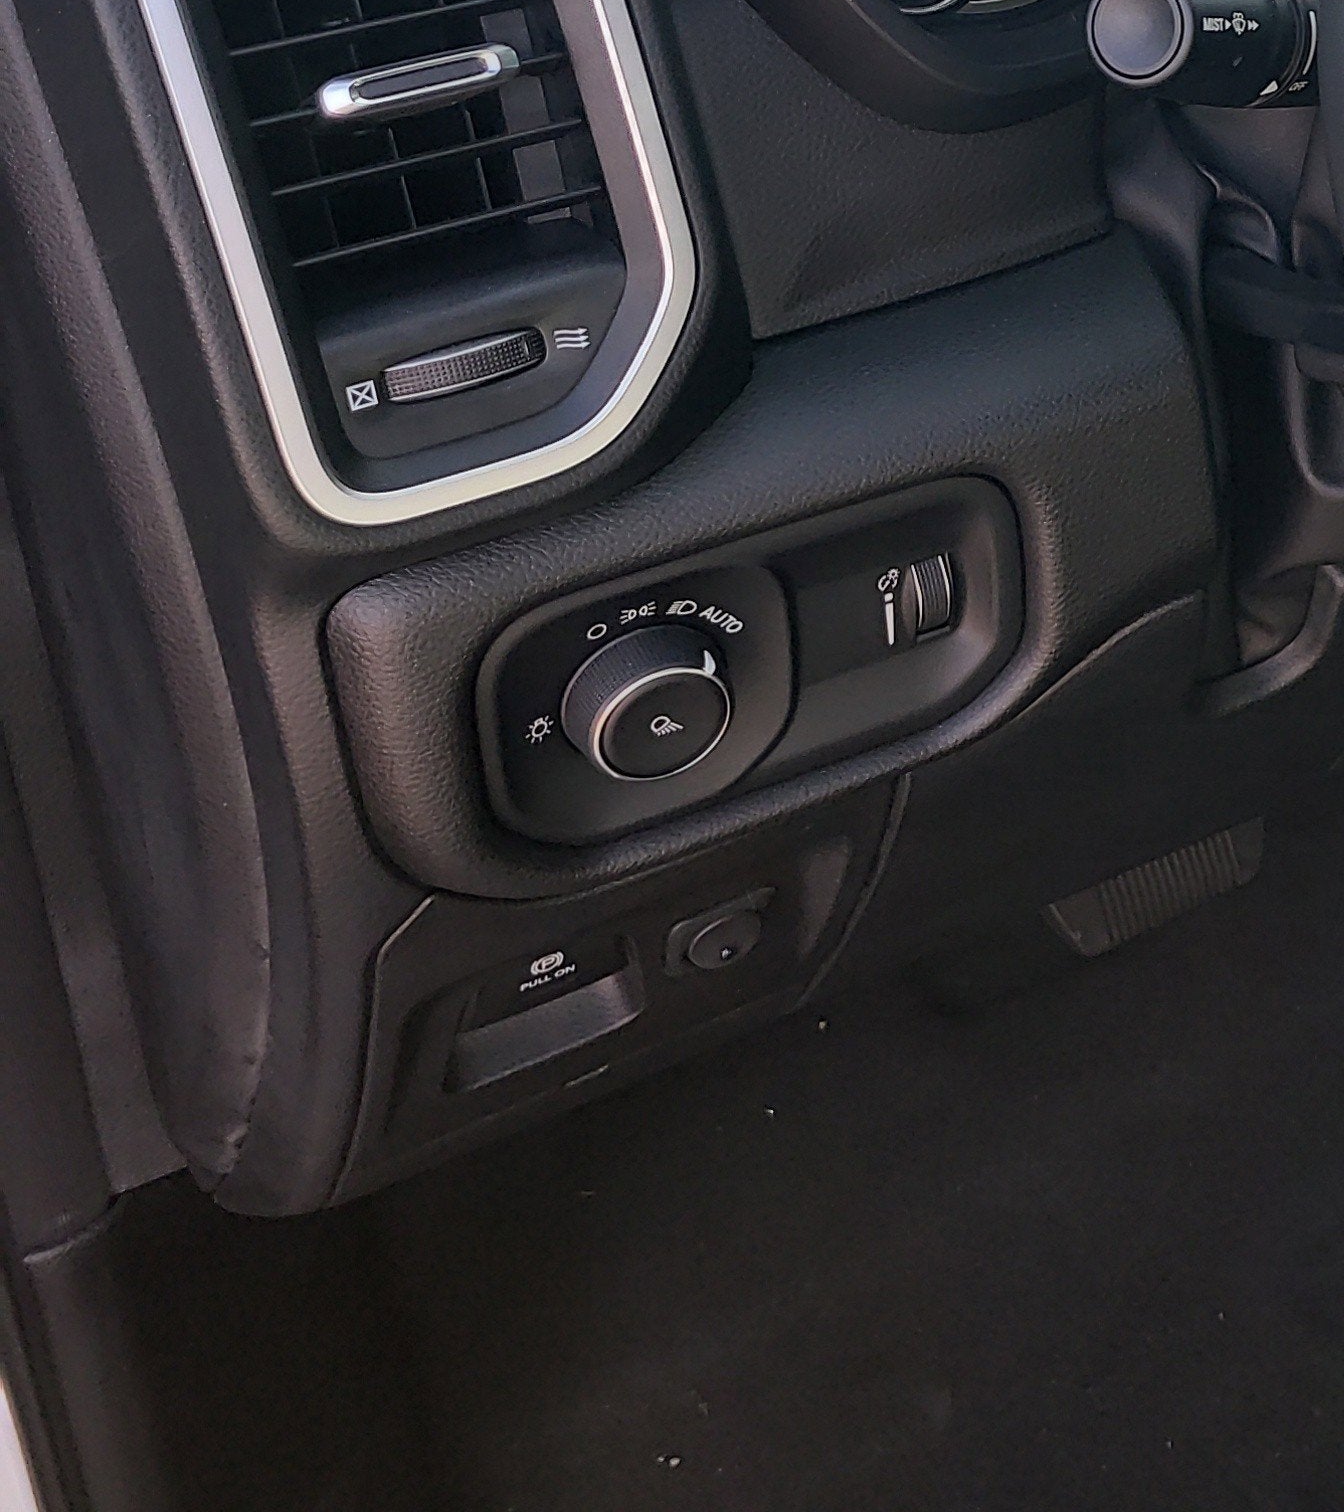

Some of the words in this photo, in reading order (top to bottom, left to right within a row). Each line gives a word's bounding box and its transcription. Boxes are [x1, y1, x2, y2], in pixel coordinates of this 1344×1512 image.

[1203, 17, 1224, 32] MIST
[699, 605, 744, 634] AUTO
[520, 975, 551, 992] PULL
[554, 964, 576, 978] ON
